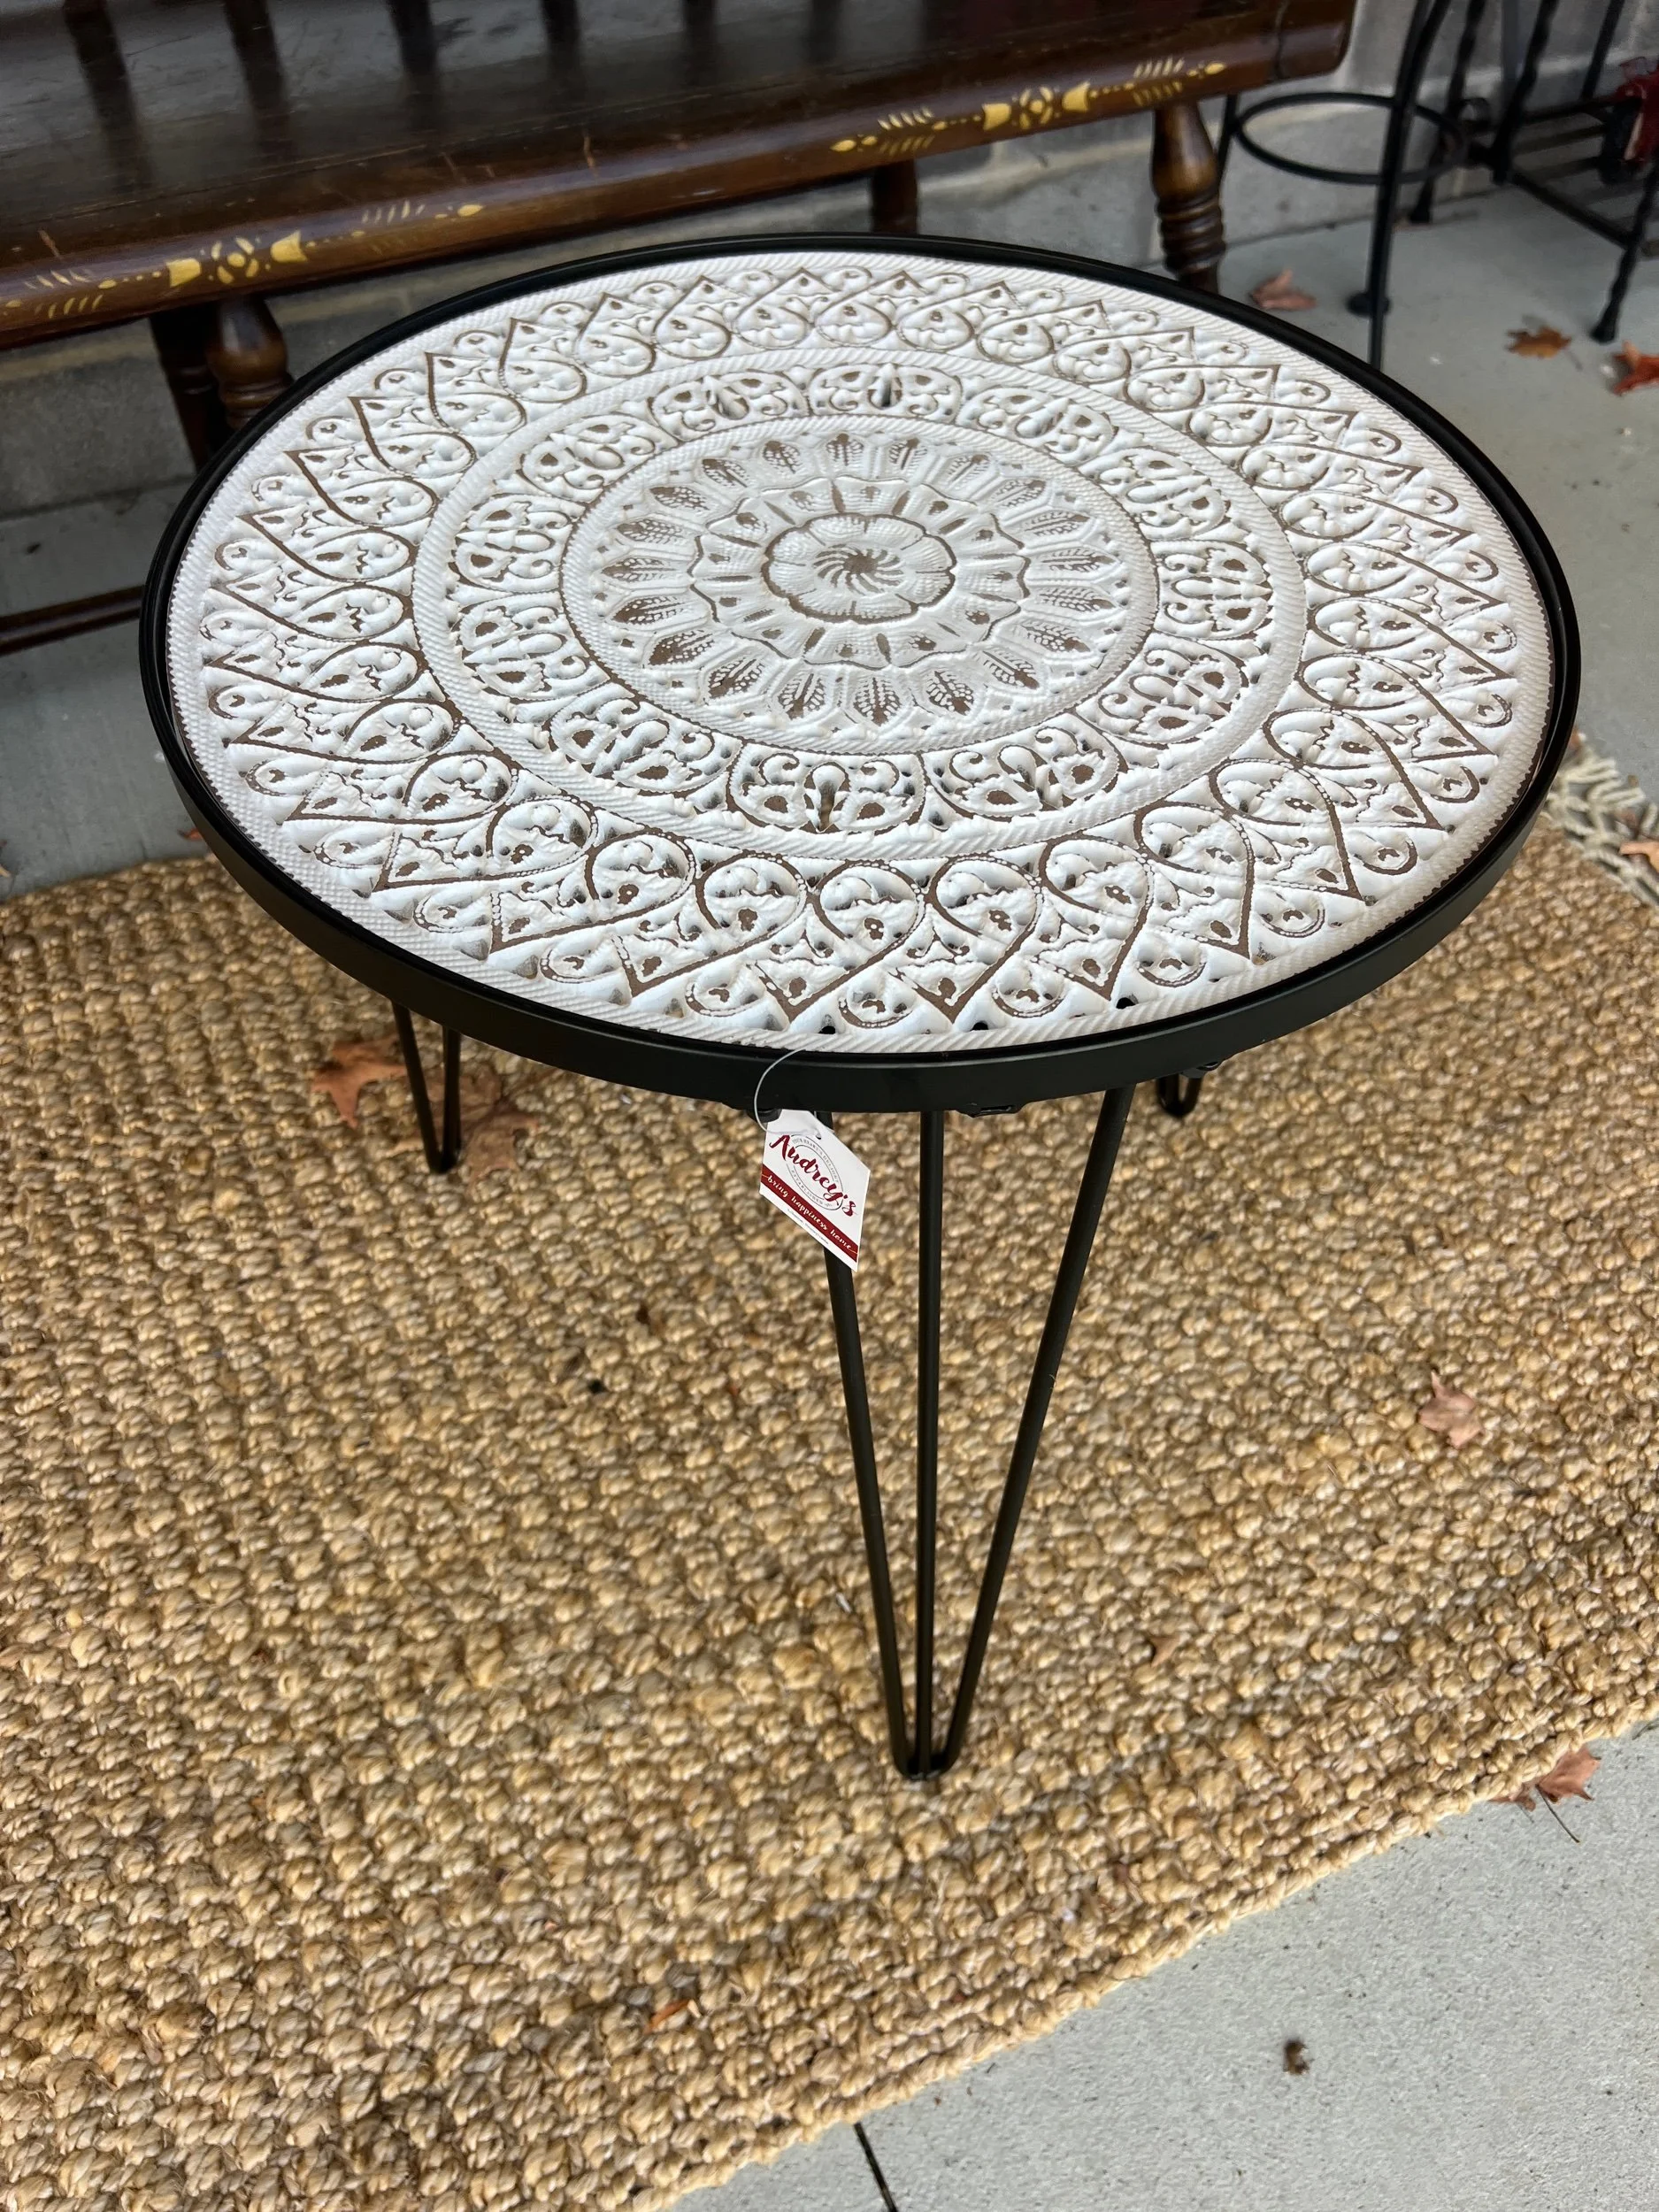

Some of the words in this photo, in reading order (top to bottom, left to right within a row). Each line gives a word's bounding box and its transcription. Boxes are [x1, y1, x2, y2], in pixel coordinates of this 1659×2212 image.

[767, 1175, 789, 1198] bring
[791, 1195, 828, 1231] happiness
[830, 1229, 852, 1250] home
[769, 1134, 856, 1217] Audrey's
